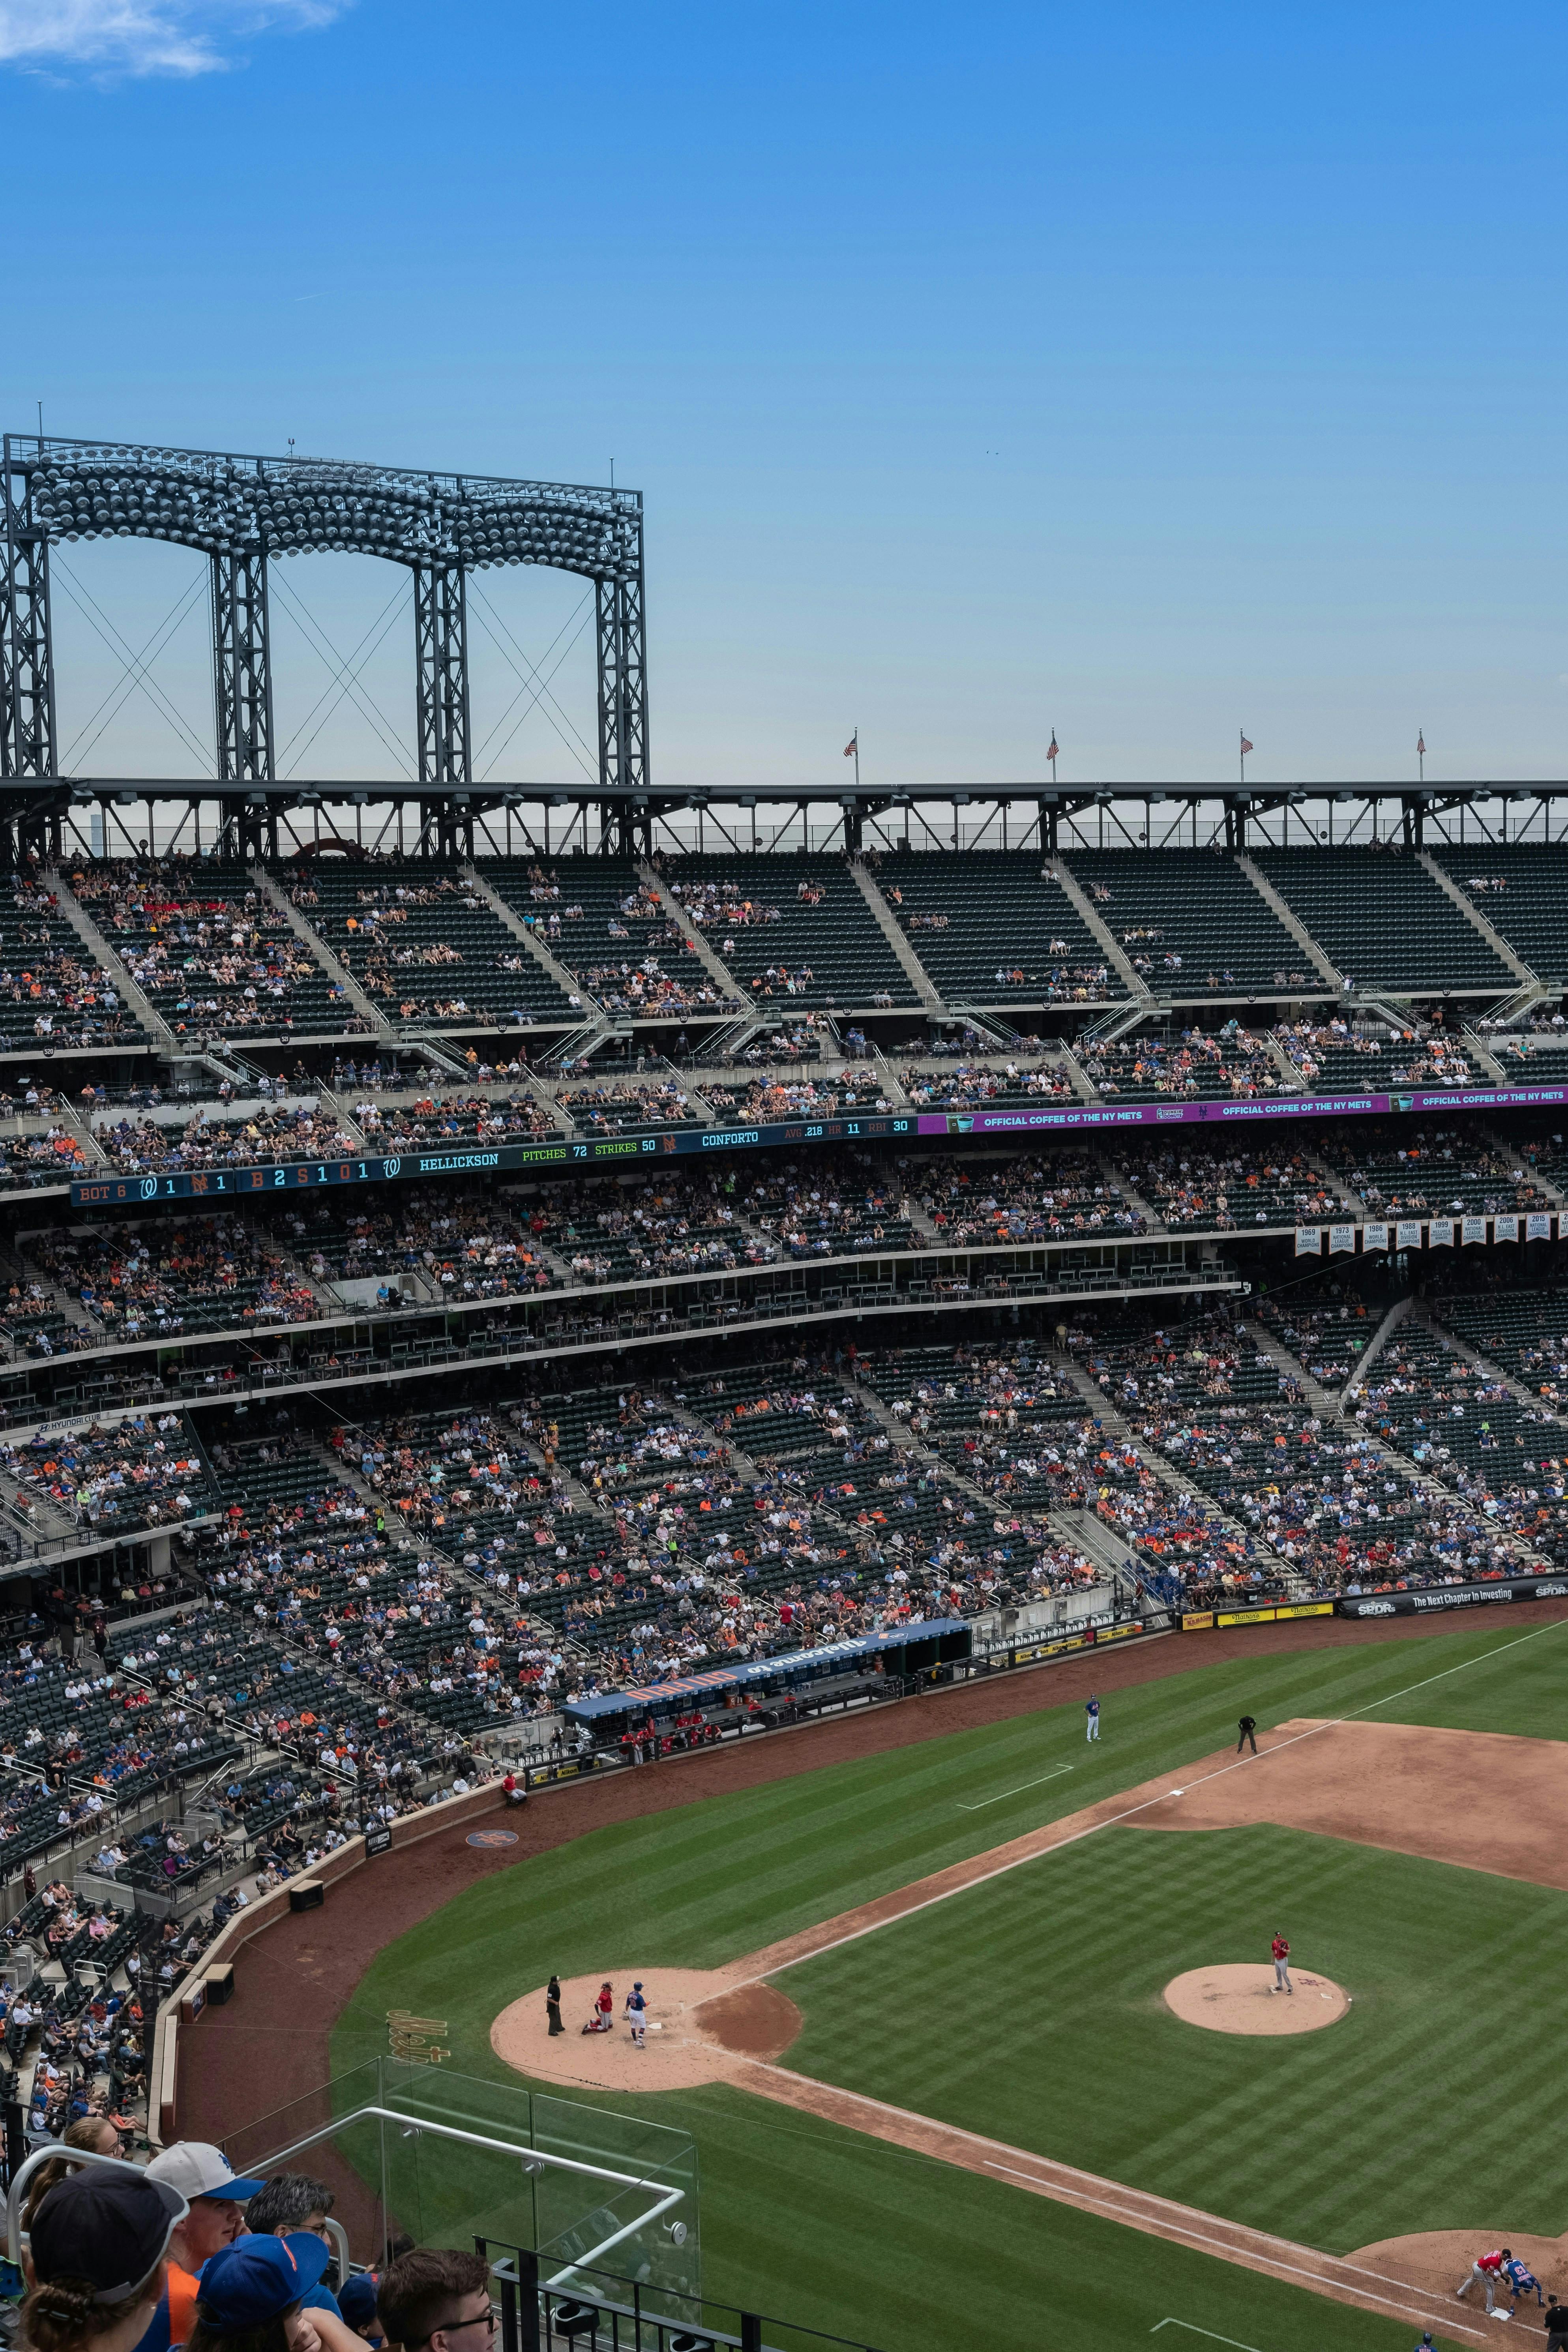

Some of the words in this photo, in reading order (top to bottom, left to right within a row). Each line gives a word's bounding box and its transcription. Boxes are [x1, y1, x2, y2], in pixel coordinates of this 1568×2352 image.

[1423, 1097, 1461, 1105] OFFICIAL
[1463, 1095, 1495, 1103] COFFEE
[1541, 1092, 1564, 1100] METS
[1223, 1106, 1263, 1115] OFFICIAL
[1265, 1104, 1299, 1113] COFFEE
[984, 1117, 1027, 1126] OFFICIAL
[1029, 1115, 1065, 1124] COFFEE
[1117, 1112, 1142, 1120] METS
[703, 1131, 758, 1146] CONFORTO
[785, 1129, 802, 1138] AVG
[805, 1126, 822, 1137] .218
[828, 1125, 841, 1134] HR
[848, 1124, 860, 1134] 11
[869, 1123, 886, 1132] RBI
[894, 1121, 908, 1131] 30
[420, 1154, 498, 1171] HELLICKSON
[523, 1149, 566, 1161] PITCHES
[573, 1146, 587, 1157] 72
[595, 1143, 637, 1155] STRIKES
[642, 1140, 655, 1151] 50
[251, 1172, 263, 1187] B
[275, 1170, 285, 1185] 2
[298, 1168, 308, 1183] S
[318, 1167, 327, 1182] 1
[359, 1163, 367, 1178] 1
[80, 1187, 110, 1200] BOT
[118, 1185, 126, 1197] 6
[167, 1180, 175, 1193] 1
[217, 1176, 225, 1189] 1
[51, 1417, 83, 1430] HYUNDAI
[84, 1414, 101, 1423] CLUB
[1413, 1597, 1426, 1607] The
[1427, 1595, 1443, 1605] Next
[1444, 1594, 1471, 1604] Chapter
[1472, 1592, 1479, 1601] In
[1480, 1588, 1512, 1600] Investing
[770, 1640, 867, 1667] Welcome
[747, 1664, 773, 1673] to
[687, 1672, 737, 1686] CITI
[625, 1682, 694, 1700] FIELD
[1514, 2265, 1525, 2275] 13
